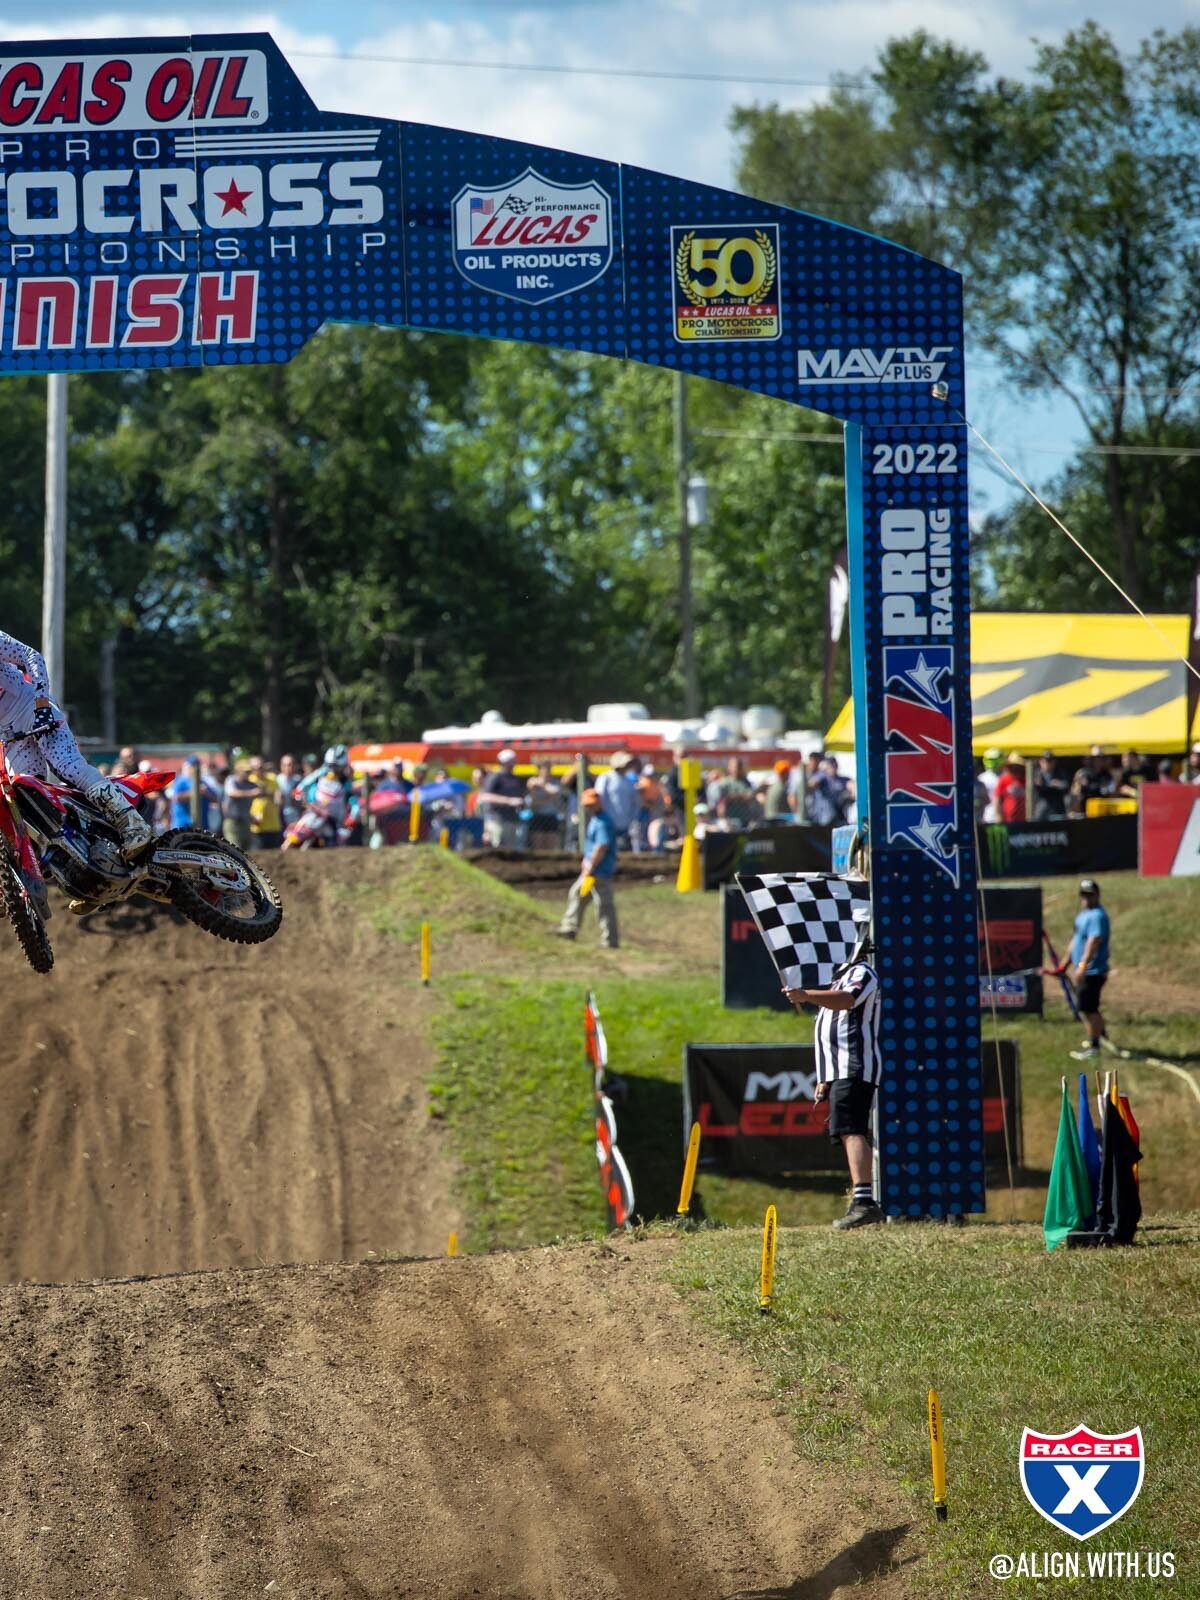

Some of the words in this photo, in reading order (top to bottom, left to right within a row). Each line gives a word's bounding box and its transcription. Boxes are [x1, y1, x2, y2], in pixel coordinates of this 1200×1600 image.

[0, 137, 160, 163] PRO
[535, 203, 601, 212] PERFORMANCE
[471, 214, 598, 246] LUCAS
[464, 256, 496, 270] OIL
[502, 253, 602, 269] PRODUCTS
[689, 237, 767, 298] 50
[682, 319, 704, 328] PRO
[708, 318, 774, 327] MOTOCROSS
[704, 307, 734, 317] LUCAS
[736, 306, 751, 315] OIL
[695, 328, 762, 336] CHAMPIONSHIP
[797, 347, 954, 378] MAVTV
[893, 365, 932, 380] PLUS
[872, 443, 958, 474] 2022
[881, 509, 928, 636] PRO
[929, 508, 954, 635] RACING
